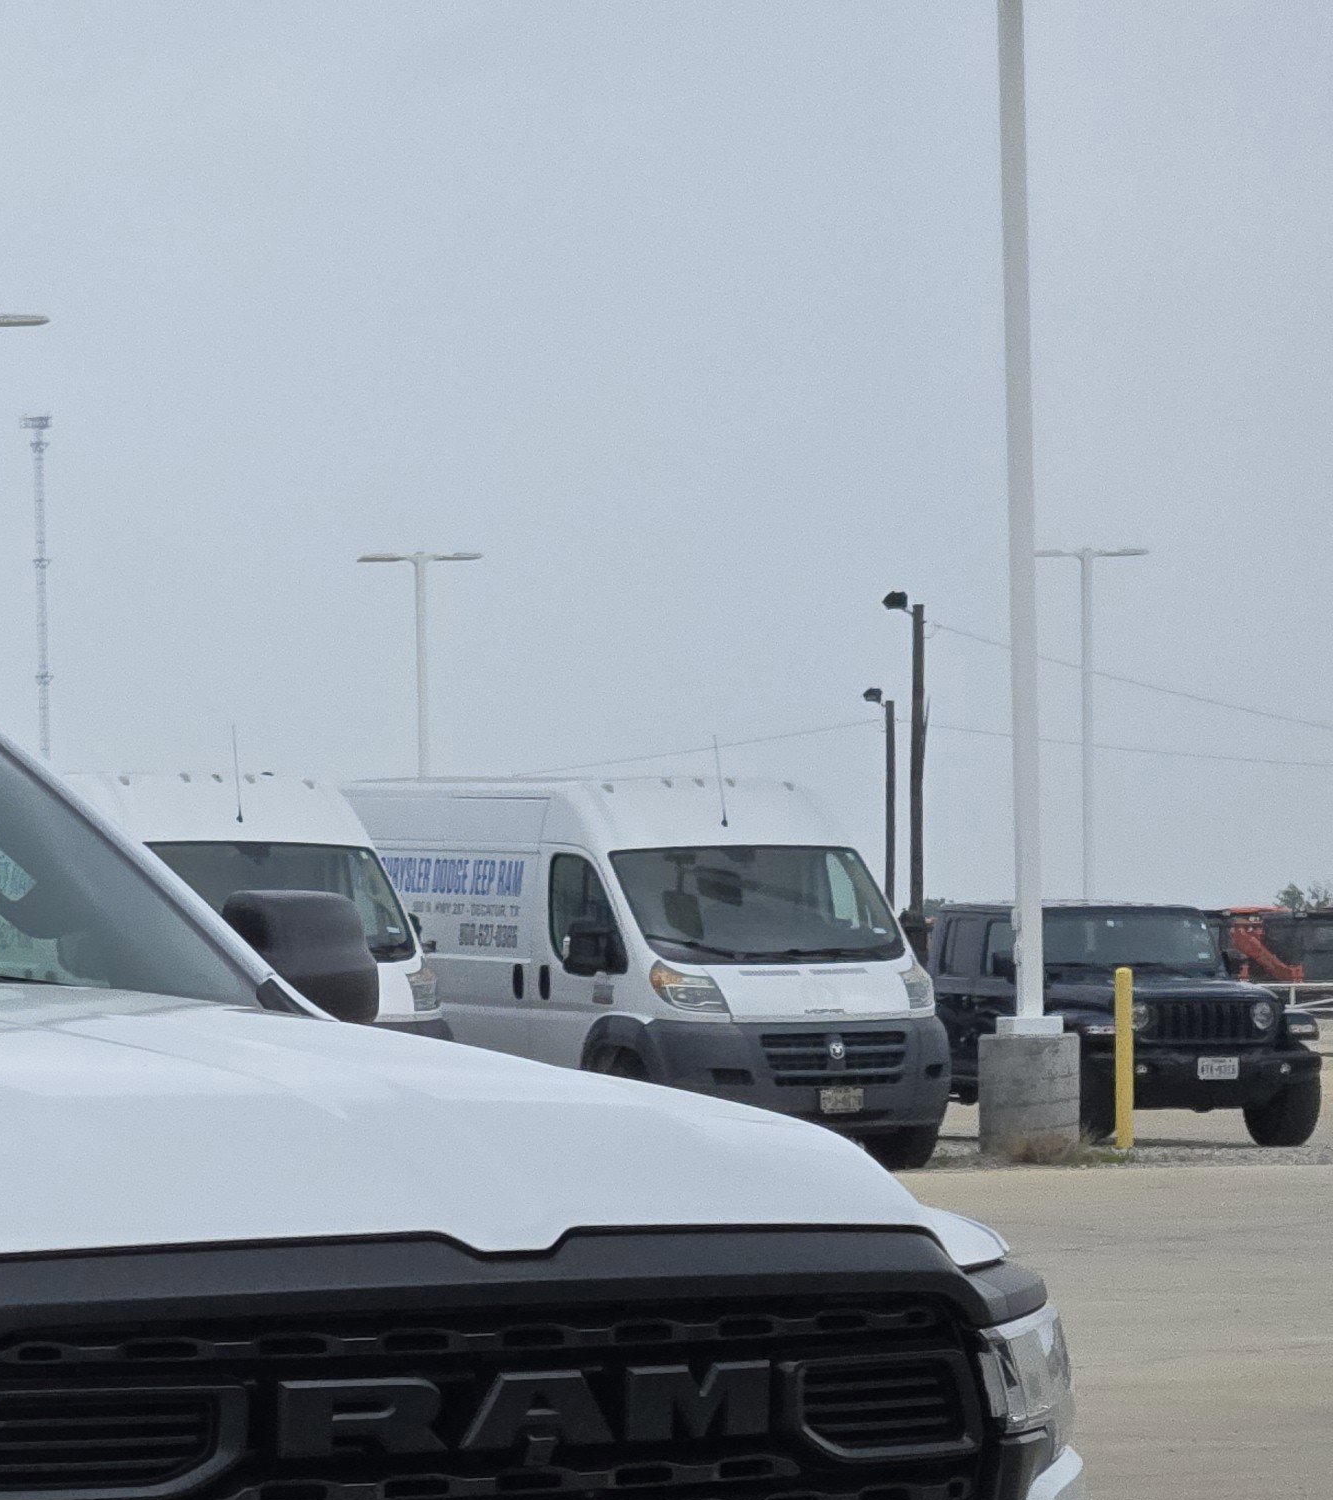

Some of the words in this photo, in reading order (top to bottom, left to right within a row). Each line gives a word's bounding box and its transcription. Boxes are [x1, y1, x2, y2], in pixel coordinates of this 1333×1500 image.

[381, 857, 432, 893] HRYSLER
[432, 859, 469, 894] DODGE
[469, 859, 496, 896] JEEP
[497, 860, 524, 897] RAM
[278, 1359, 770, 1459] RAM
